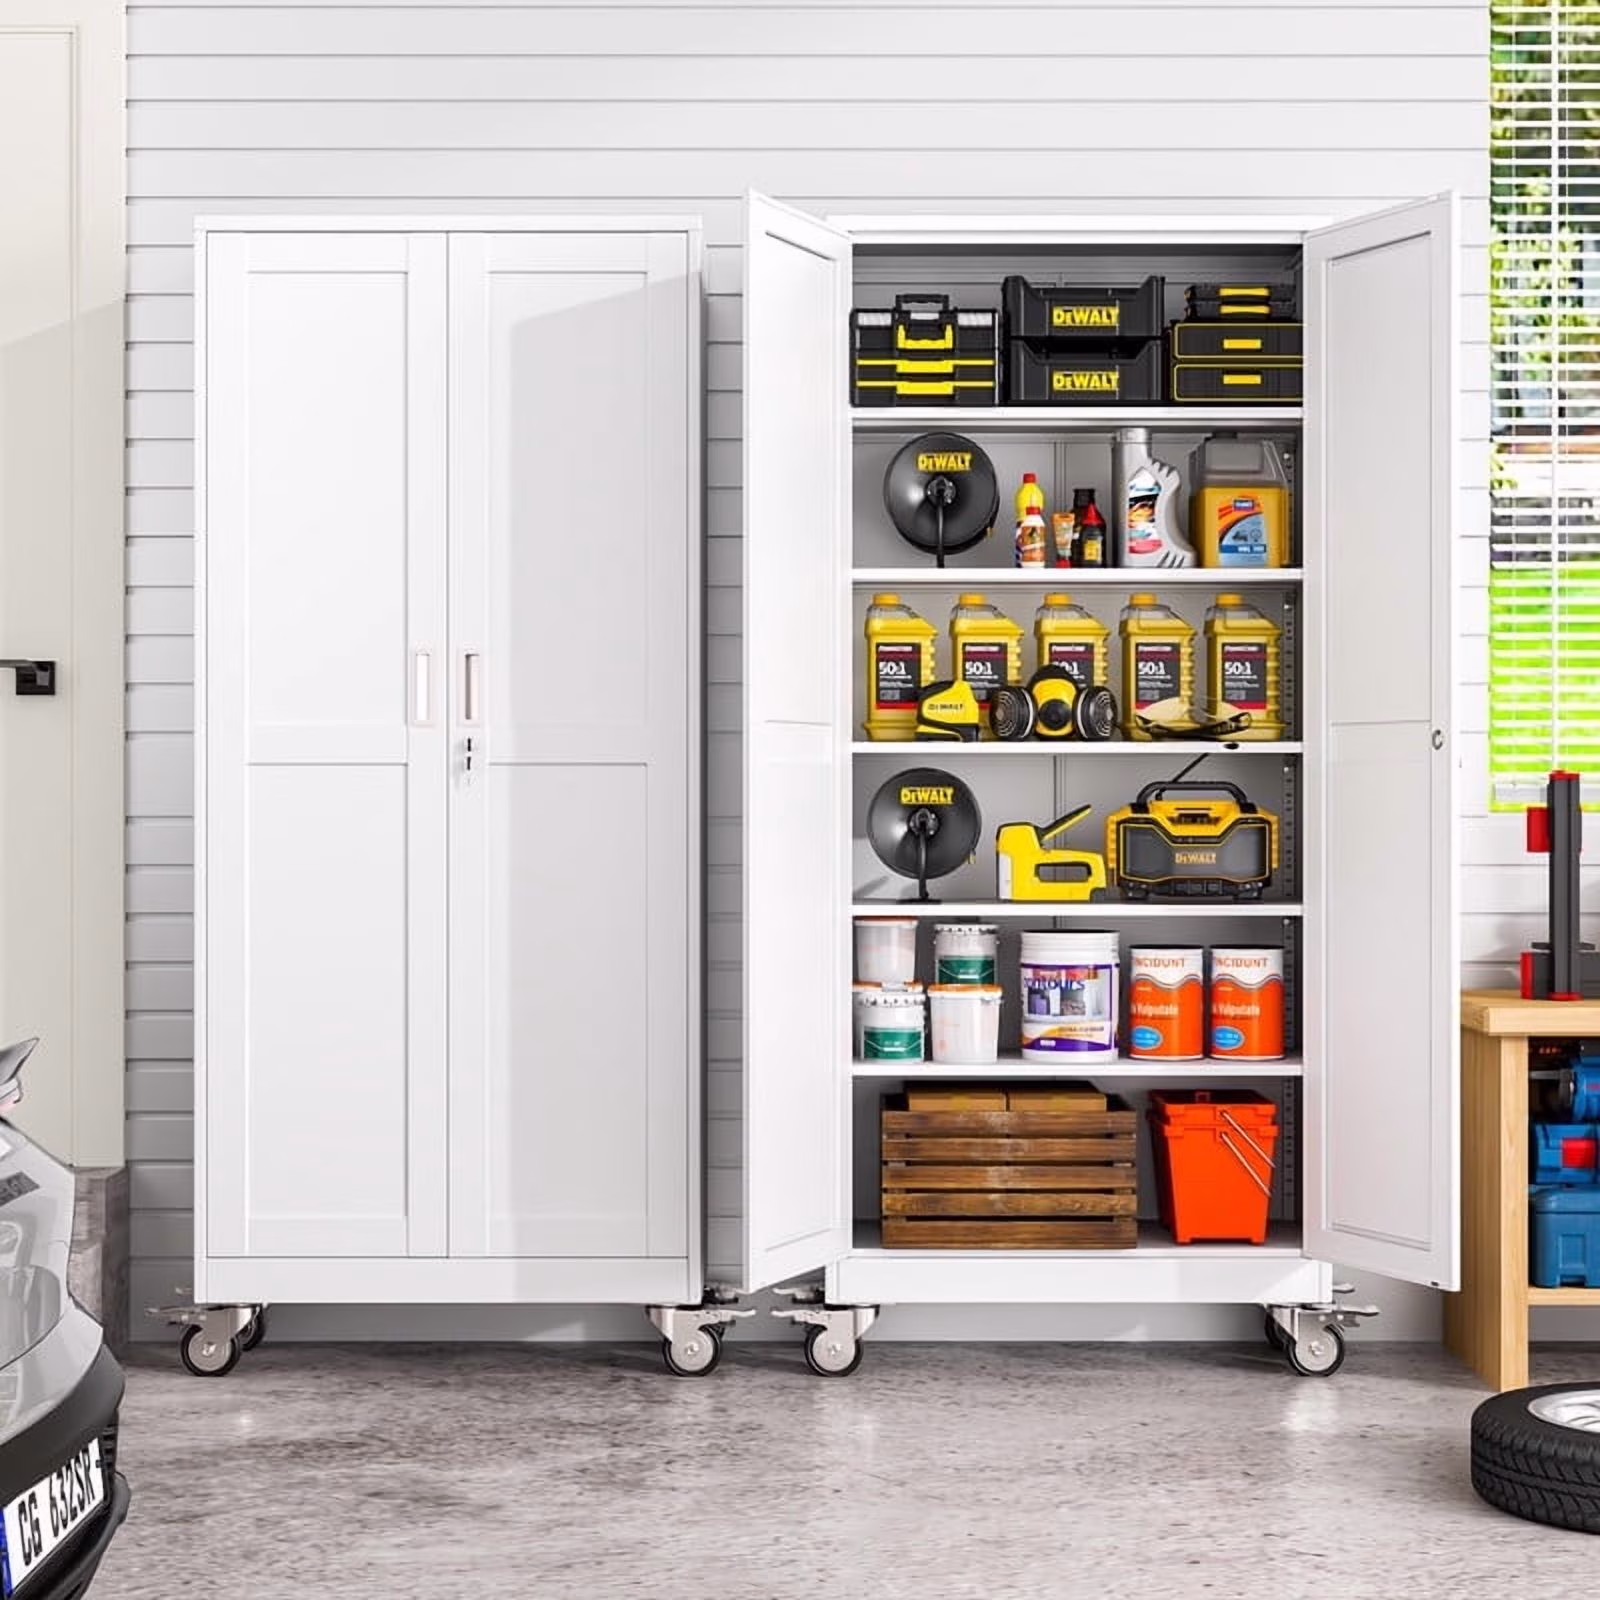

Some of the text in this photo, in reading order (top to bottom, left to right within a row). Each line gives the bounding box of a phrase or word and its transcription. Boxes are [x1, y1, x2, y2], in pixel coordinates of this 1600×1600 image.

[879, 661, 907, 675] 50:1
[965, 661, 993, 675] 50:1
[1138, 661, 1166, 675] 50:1
[1224, 661, 1252, 675] 50:1
[18, 1491, 43, 1566] CG
